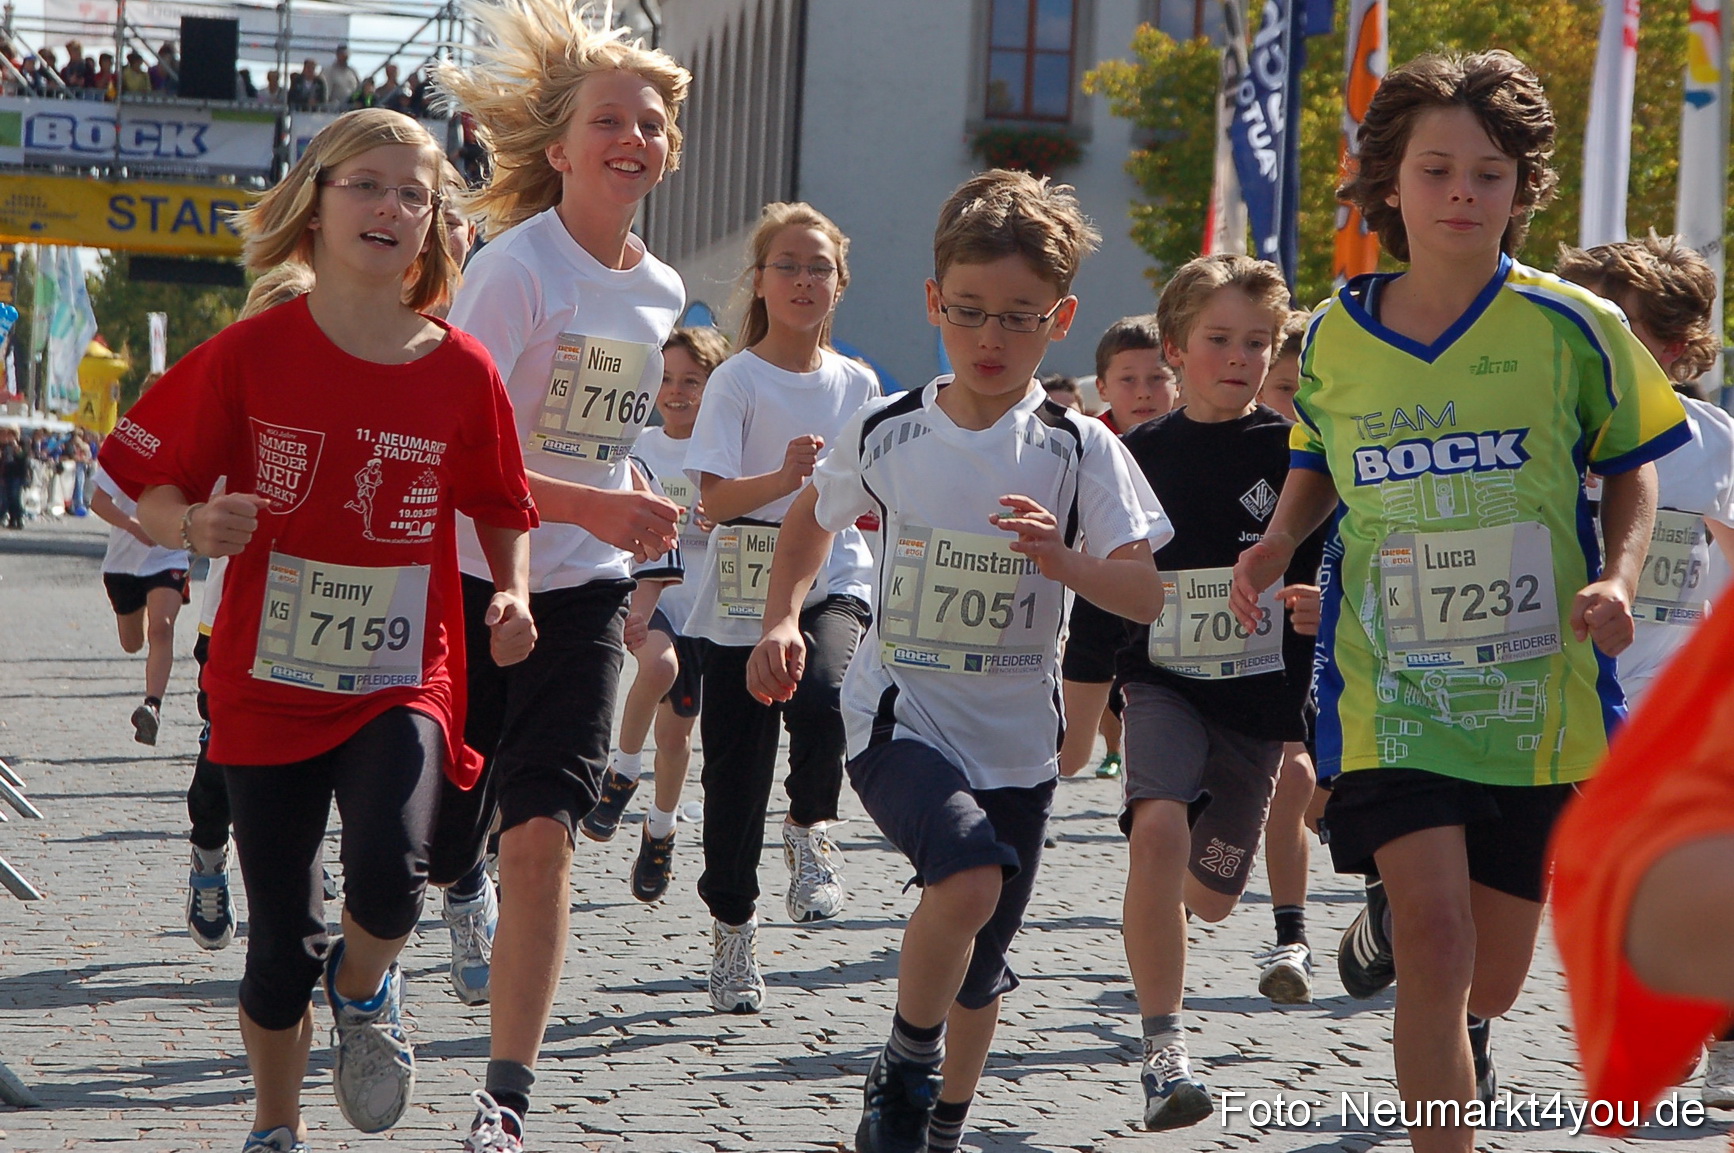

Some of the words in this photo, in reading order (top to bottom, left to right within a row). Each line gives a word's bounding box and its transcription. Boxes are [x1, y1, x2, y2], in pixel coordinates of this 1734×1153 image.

[26, 112, 209, 158] BOCK
[107, 194, 251, 236] STAR
[588, 346, 622, 373] Nina
[550, 379, 569, 397] K5
[581, 385, 650, 425] 7166
[1351, 400, 1457, 440] TEAM
[259, 431, 307, 457] IMMER
[356, 428, 376, 443] 11.
[543, 439, 581, 452] BOCK
[258, 444, 307, 472] WIEDER
[1353, 429, 1531, 487] BOCK
[257, 460, 302, 490] NEU
[256, 480, 297, 505] MARKT
[746, 534, 774, 552] Meli
[721, 561, 735, 574] K5
[935, 539, 1041, 575] Constanti
[1424, 543, 1477, 570] Luca
[748, 563, 771, 588] 7
[892, 576, 904, 597] K
[311, 571, 373, 606] Fanny
[1388, 587, 1400, 607] K
[1431, 574, 1541, 623] 7232
[269, 600, 290, 621] K5
[934, 585, 1037, 630] 7051
[1157, 613, 1166, 627] K
[310, 611, 411, 652] 7159
[1496, 633, 1558, 655] PFLEIDERER
[895, 648, 940, 662] BOCK
[984, 654, 1043, 667] PFLEIDERER
[1235, 653, 1281, 670] PFLEIDERER
[1406, 651, 1452, 664] BOCK
[271, 665, 314, 682] BOCK
[356, 675, 418, 686] PFLEIDERER
[1200, 845, 1241, 878] 28
